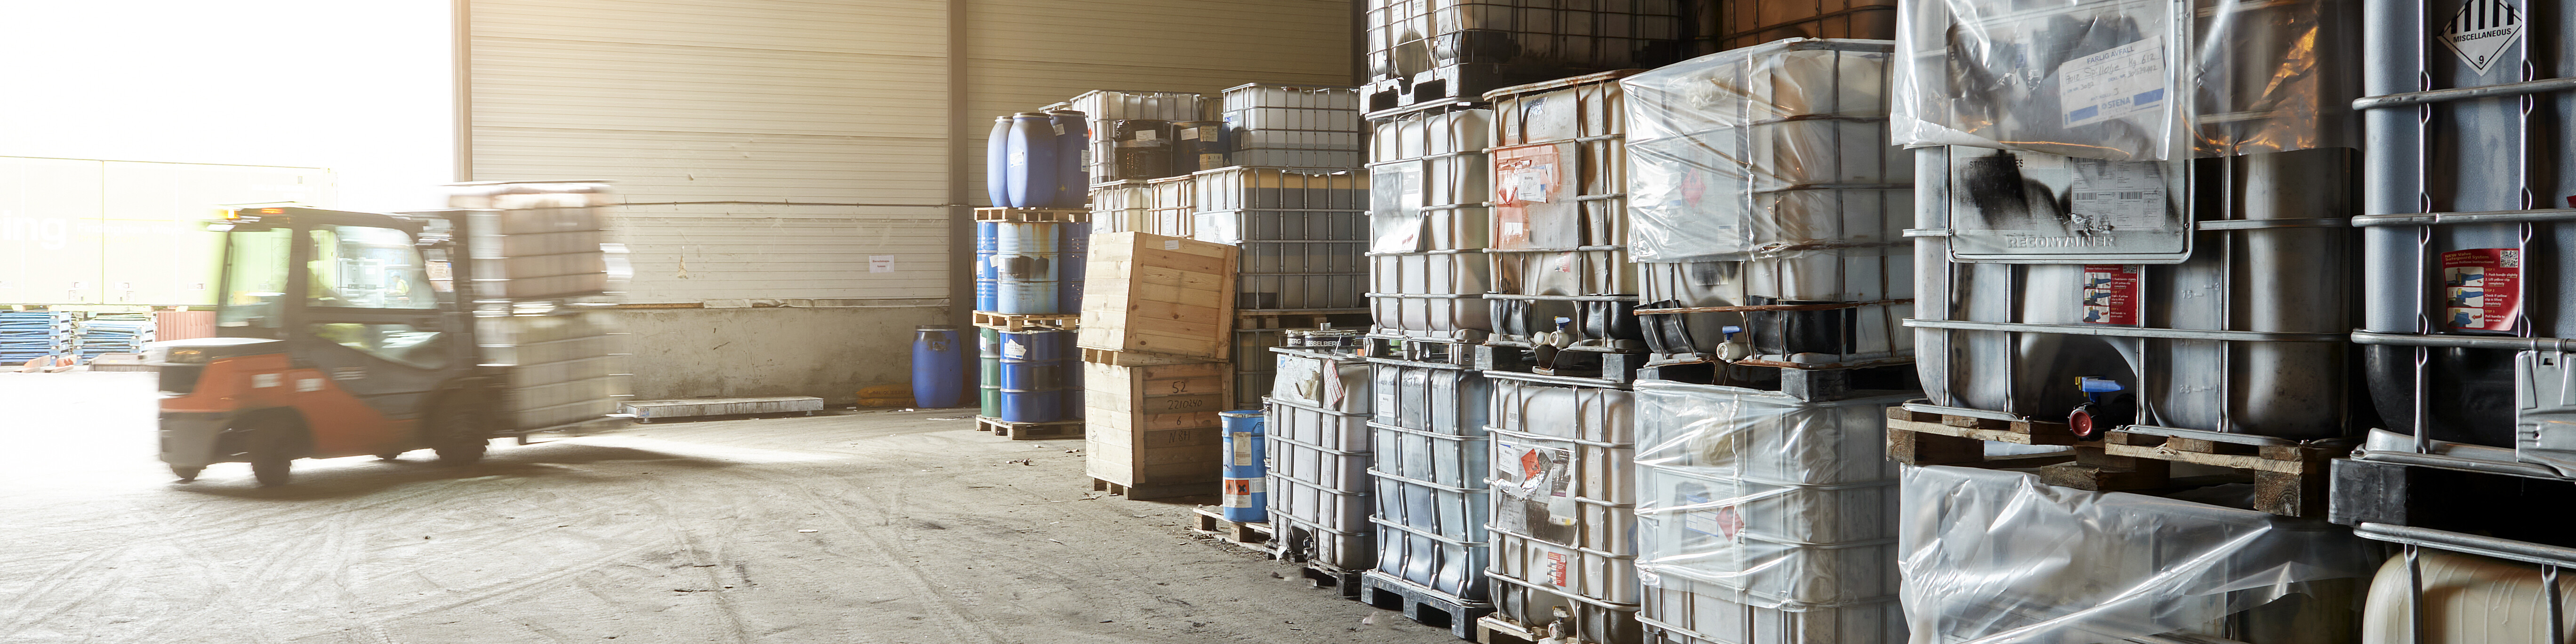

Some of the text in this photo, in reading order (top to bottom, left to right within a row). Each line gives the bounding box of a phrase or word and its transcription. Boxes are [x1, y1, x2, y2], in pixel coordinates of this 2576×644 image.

[2453, 28, 2511, 43] MISCELLANEOUS
[2087, 46, 2134, 64] FARLIG AVFALL
[2141, 54, 2156, 64] 612
[2479, 56, 2484, 64] 9
[2108, 97, 2131, 108] STENA
[1970, 159, 2023, 169] STOKMAES
[0, 210, 66, 250] ing
[2007, 236, 2117, 248] RECONTAINER
[2181, 290, 2193, 299] 75
[1172, 381, 1188, 394] 52
[2180, 385, 2191, 394] 25
[1167, 399, 1202, 410] 2210240
[1176, 416, 1182, 426] 6
